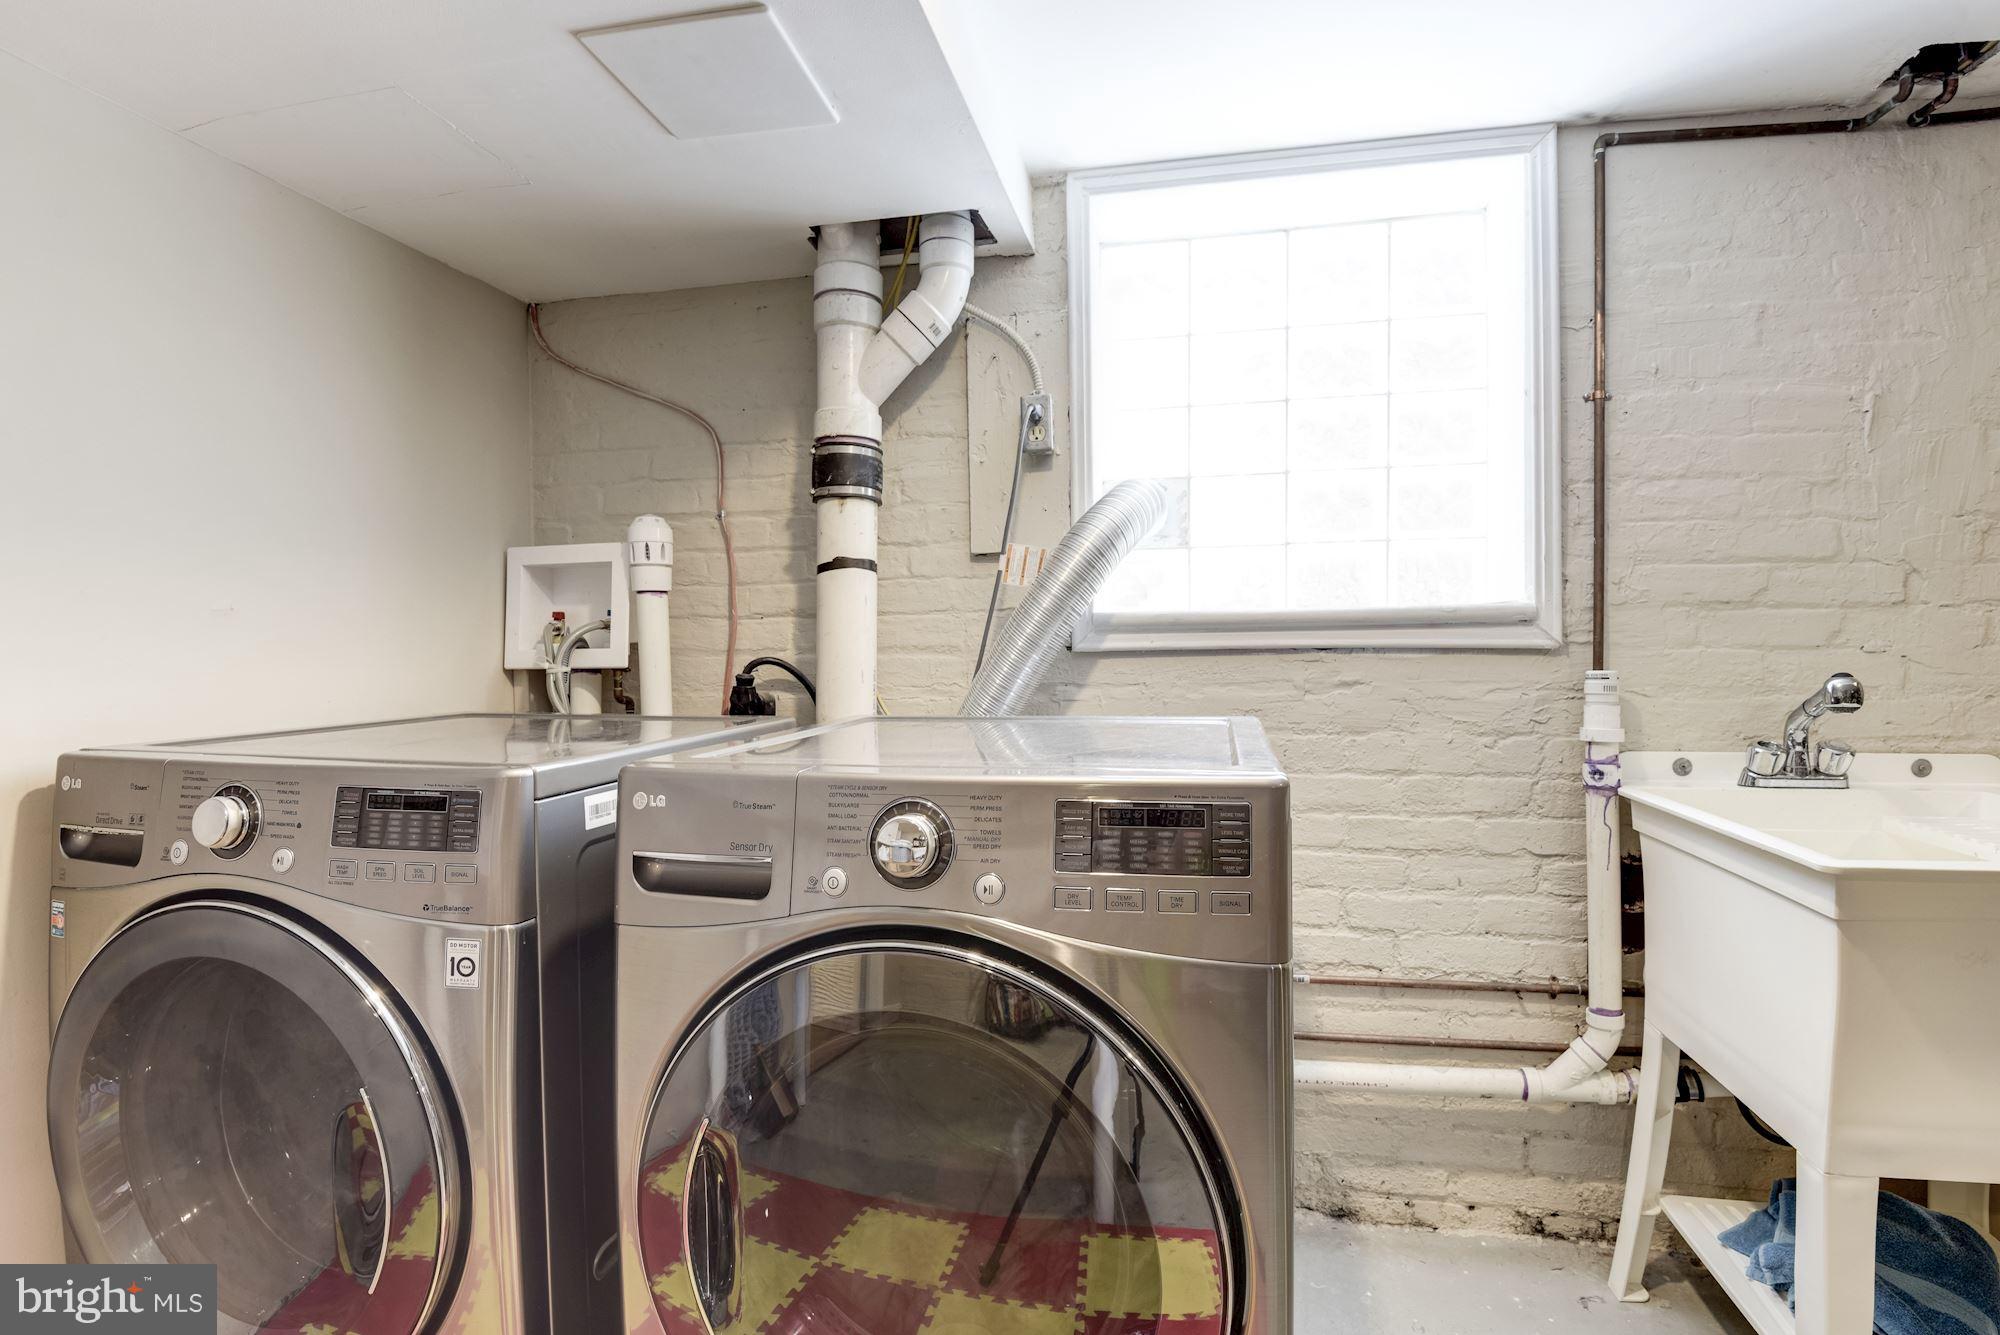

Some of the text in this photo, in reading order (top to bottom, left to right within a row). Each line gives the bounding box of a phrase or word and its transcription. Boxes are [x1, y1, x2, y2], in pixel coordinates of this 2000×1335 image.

[730, 842, 773, 852] Sensor Dry
[450, 956, 476, 978] 10
